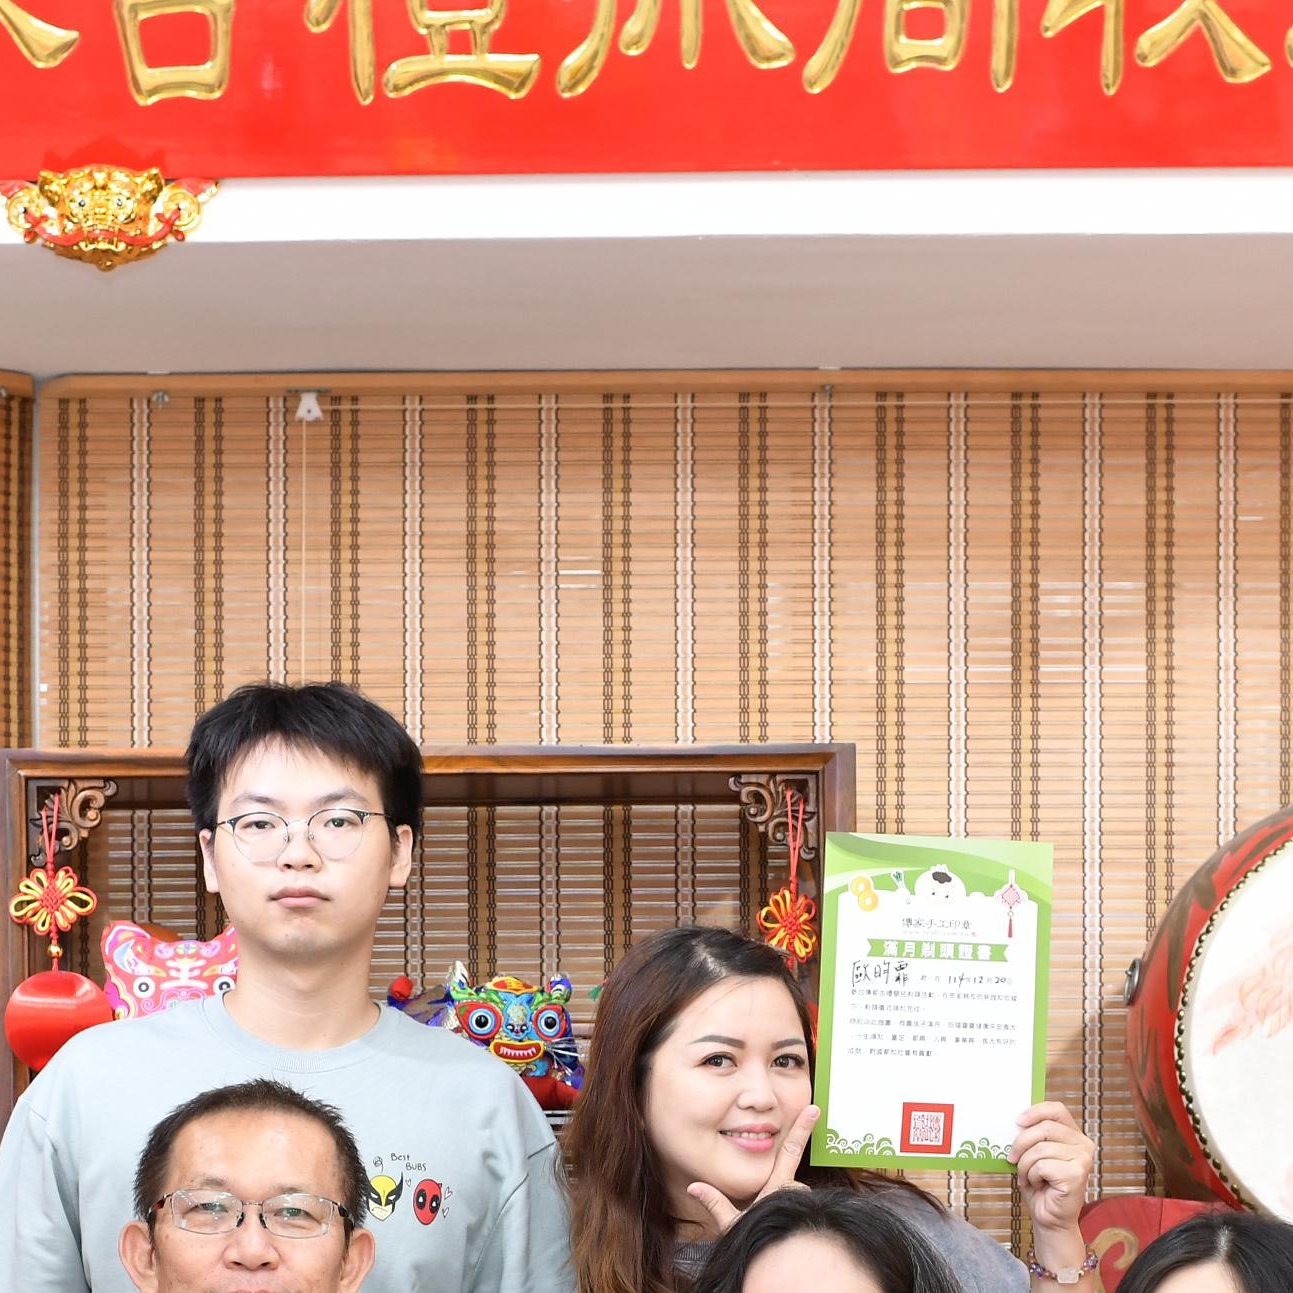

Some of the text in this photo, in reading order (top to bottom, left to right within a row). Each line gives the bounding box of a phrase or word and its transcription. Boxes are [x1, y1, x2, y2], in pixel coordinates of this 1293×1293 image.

[902, 917, 971, 930] 傳家手工印章
[390, 1153, 410, 1161] Best
[405, 1162, 427, 1171] BUBS
